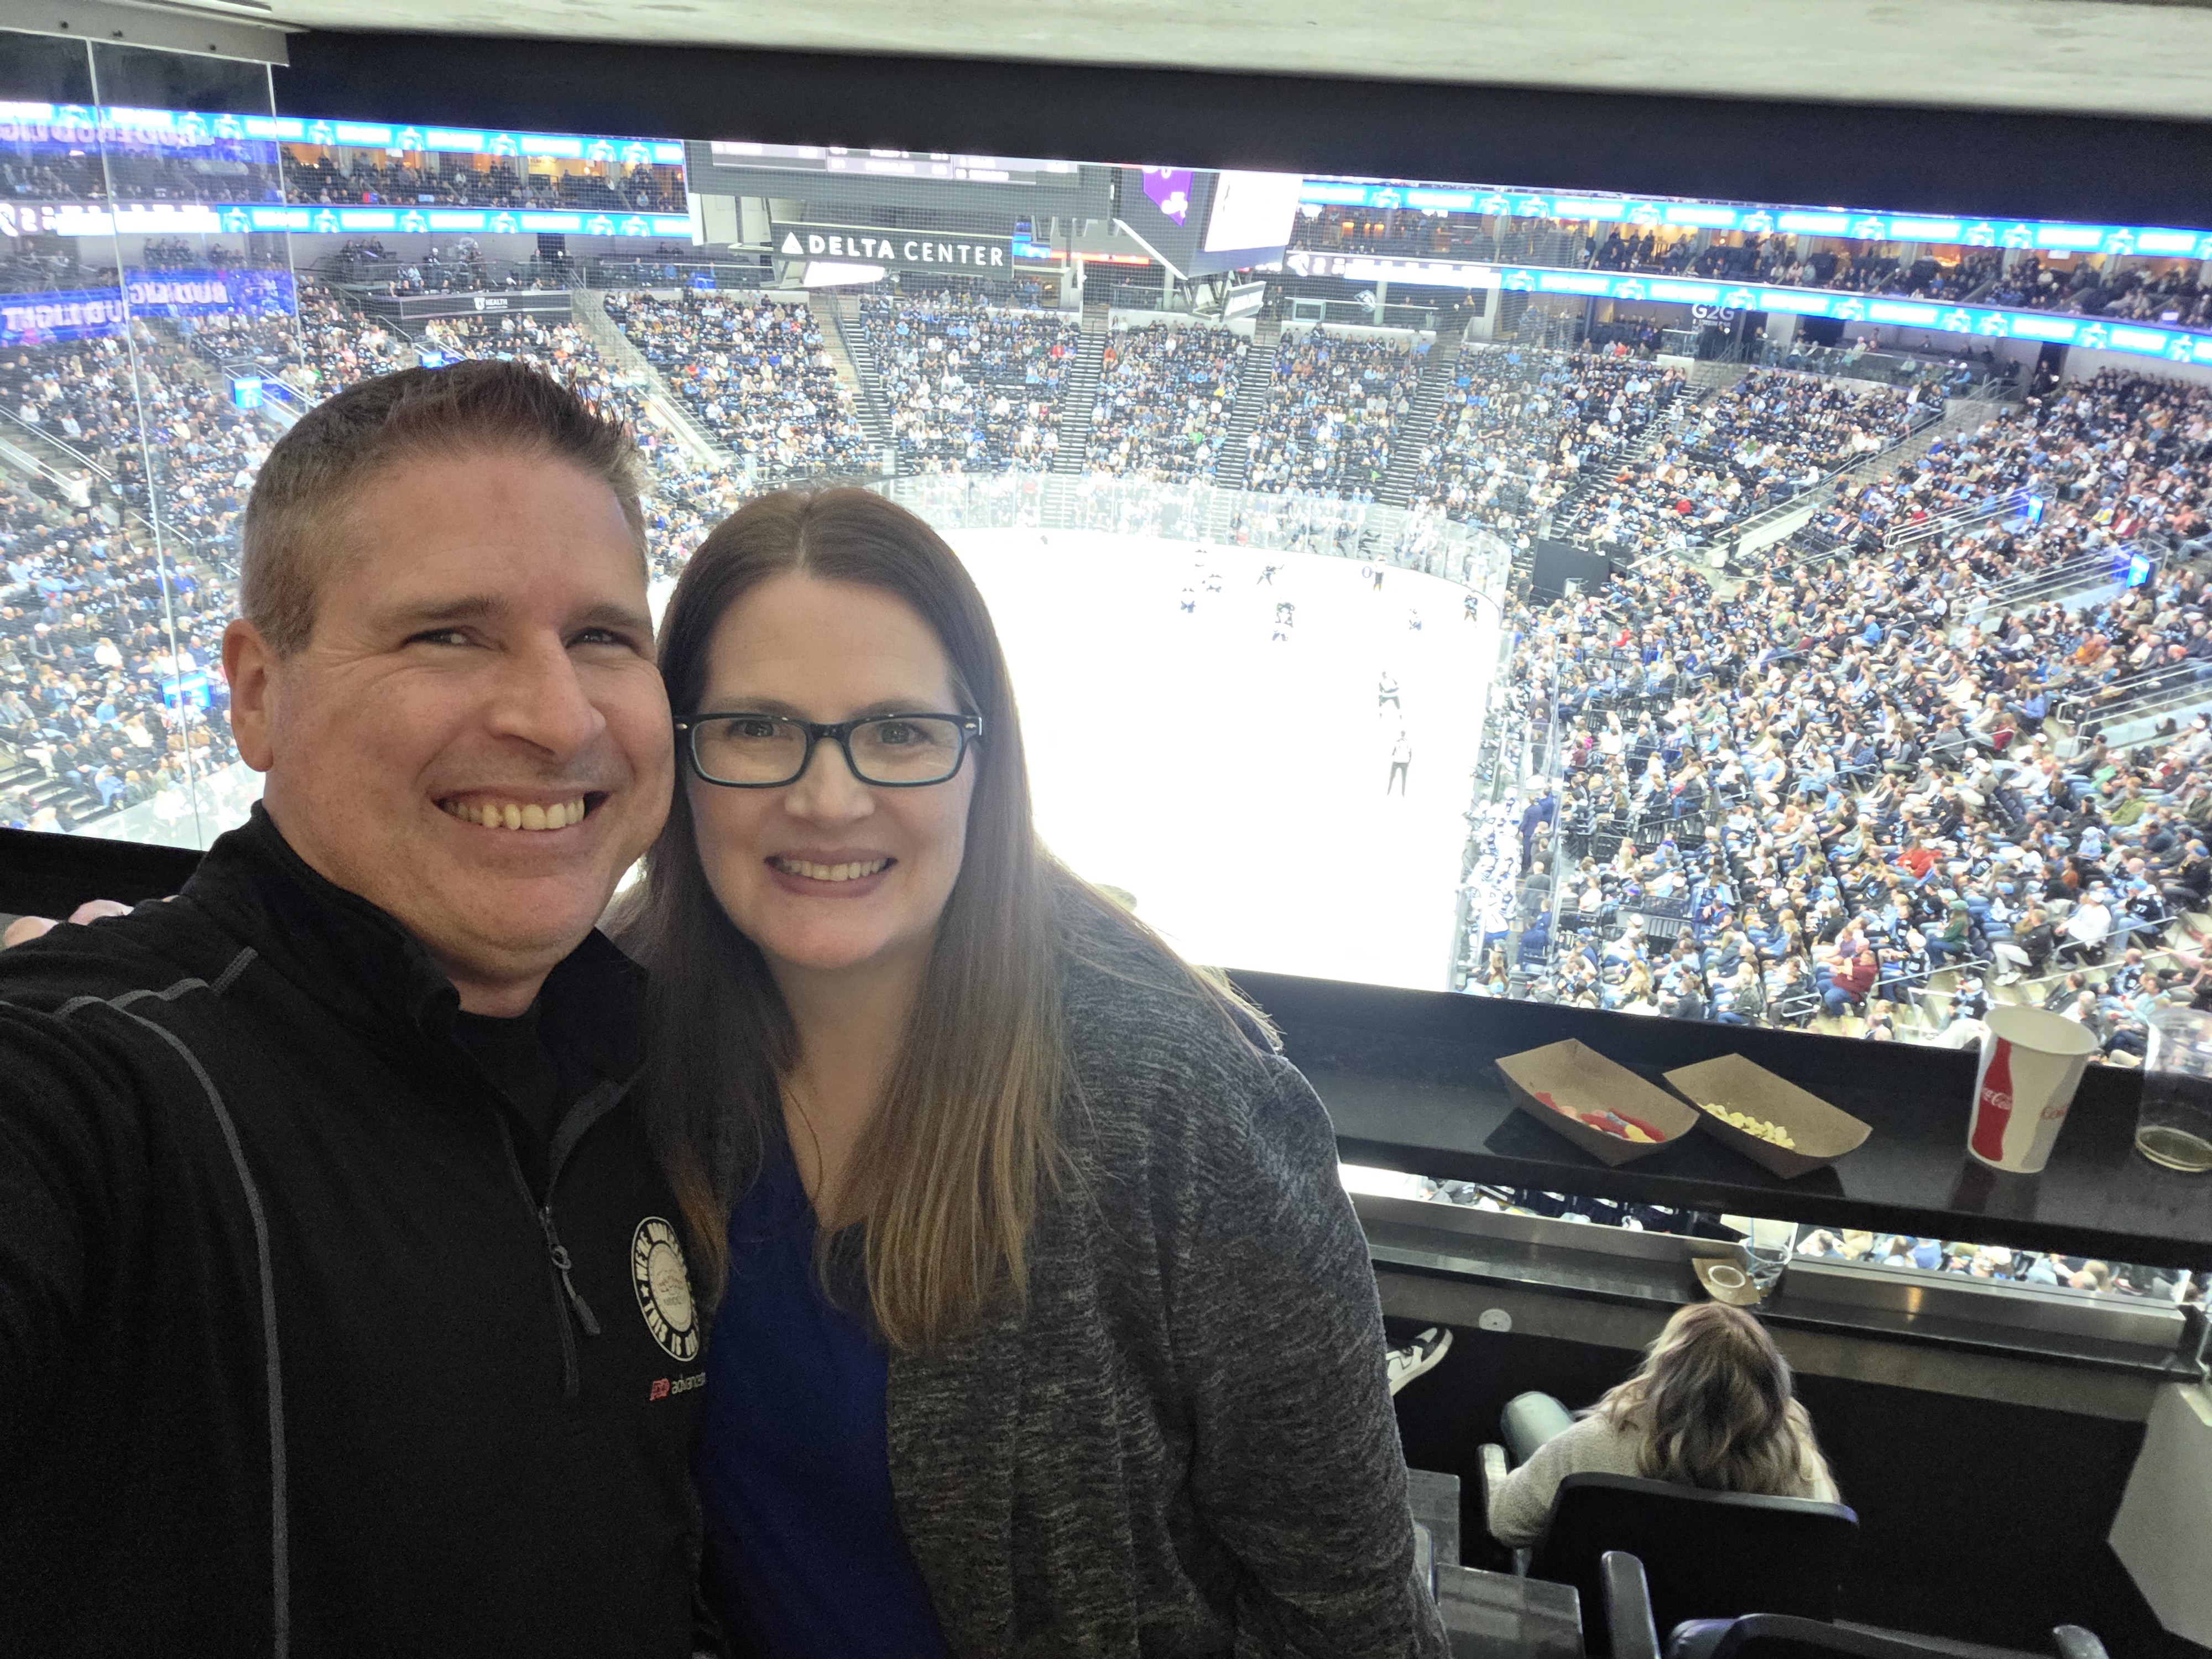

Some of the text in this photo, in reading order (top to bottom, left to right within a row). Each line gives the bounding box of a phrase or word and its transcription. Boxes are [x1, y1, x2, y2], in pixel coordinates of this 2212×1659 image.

[809, 234, 1003, 267] DELTA CENTER
[1692, 304, 1735, 320] G2G
